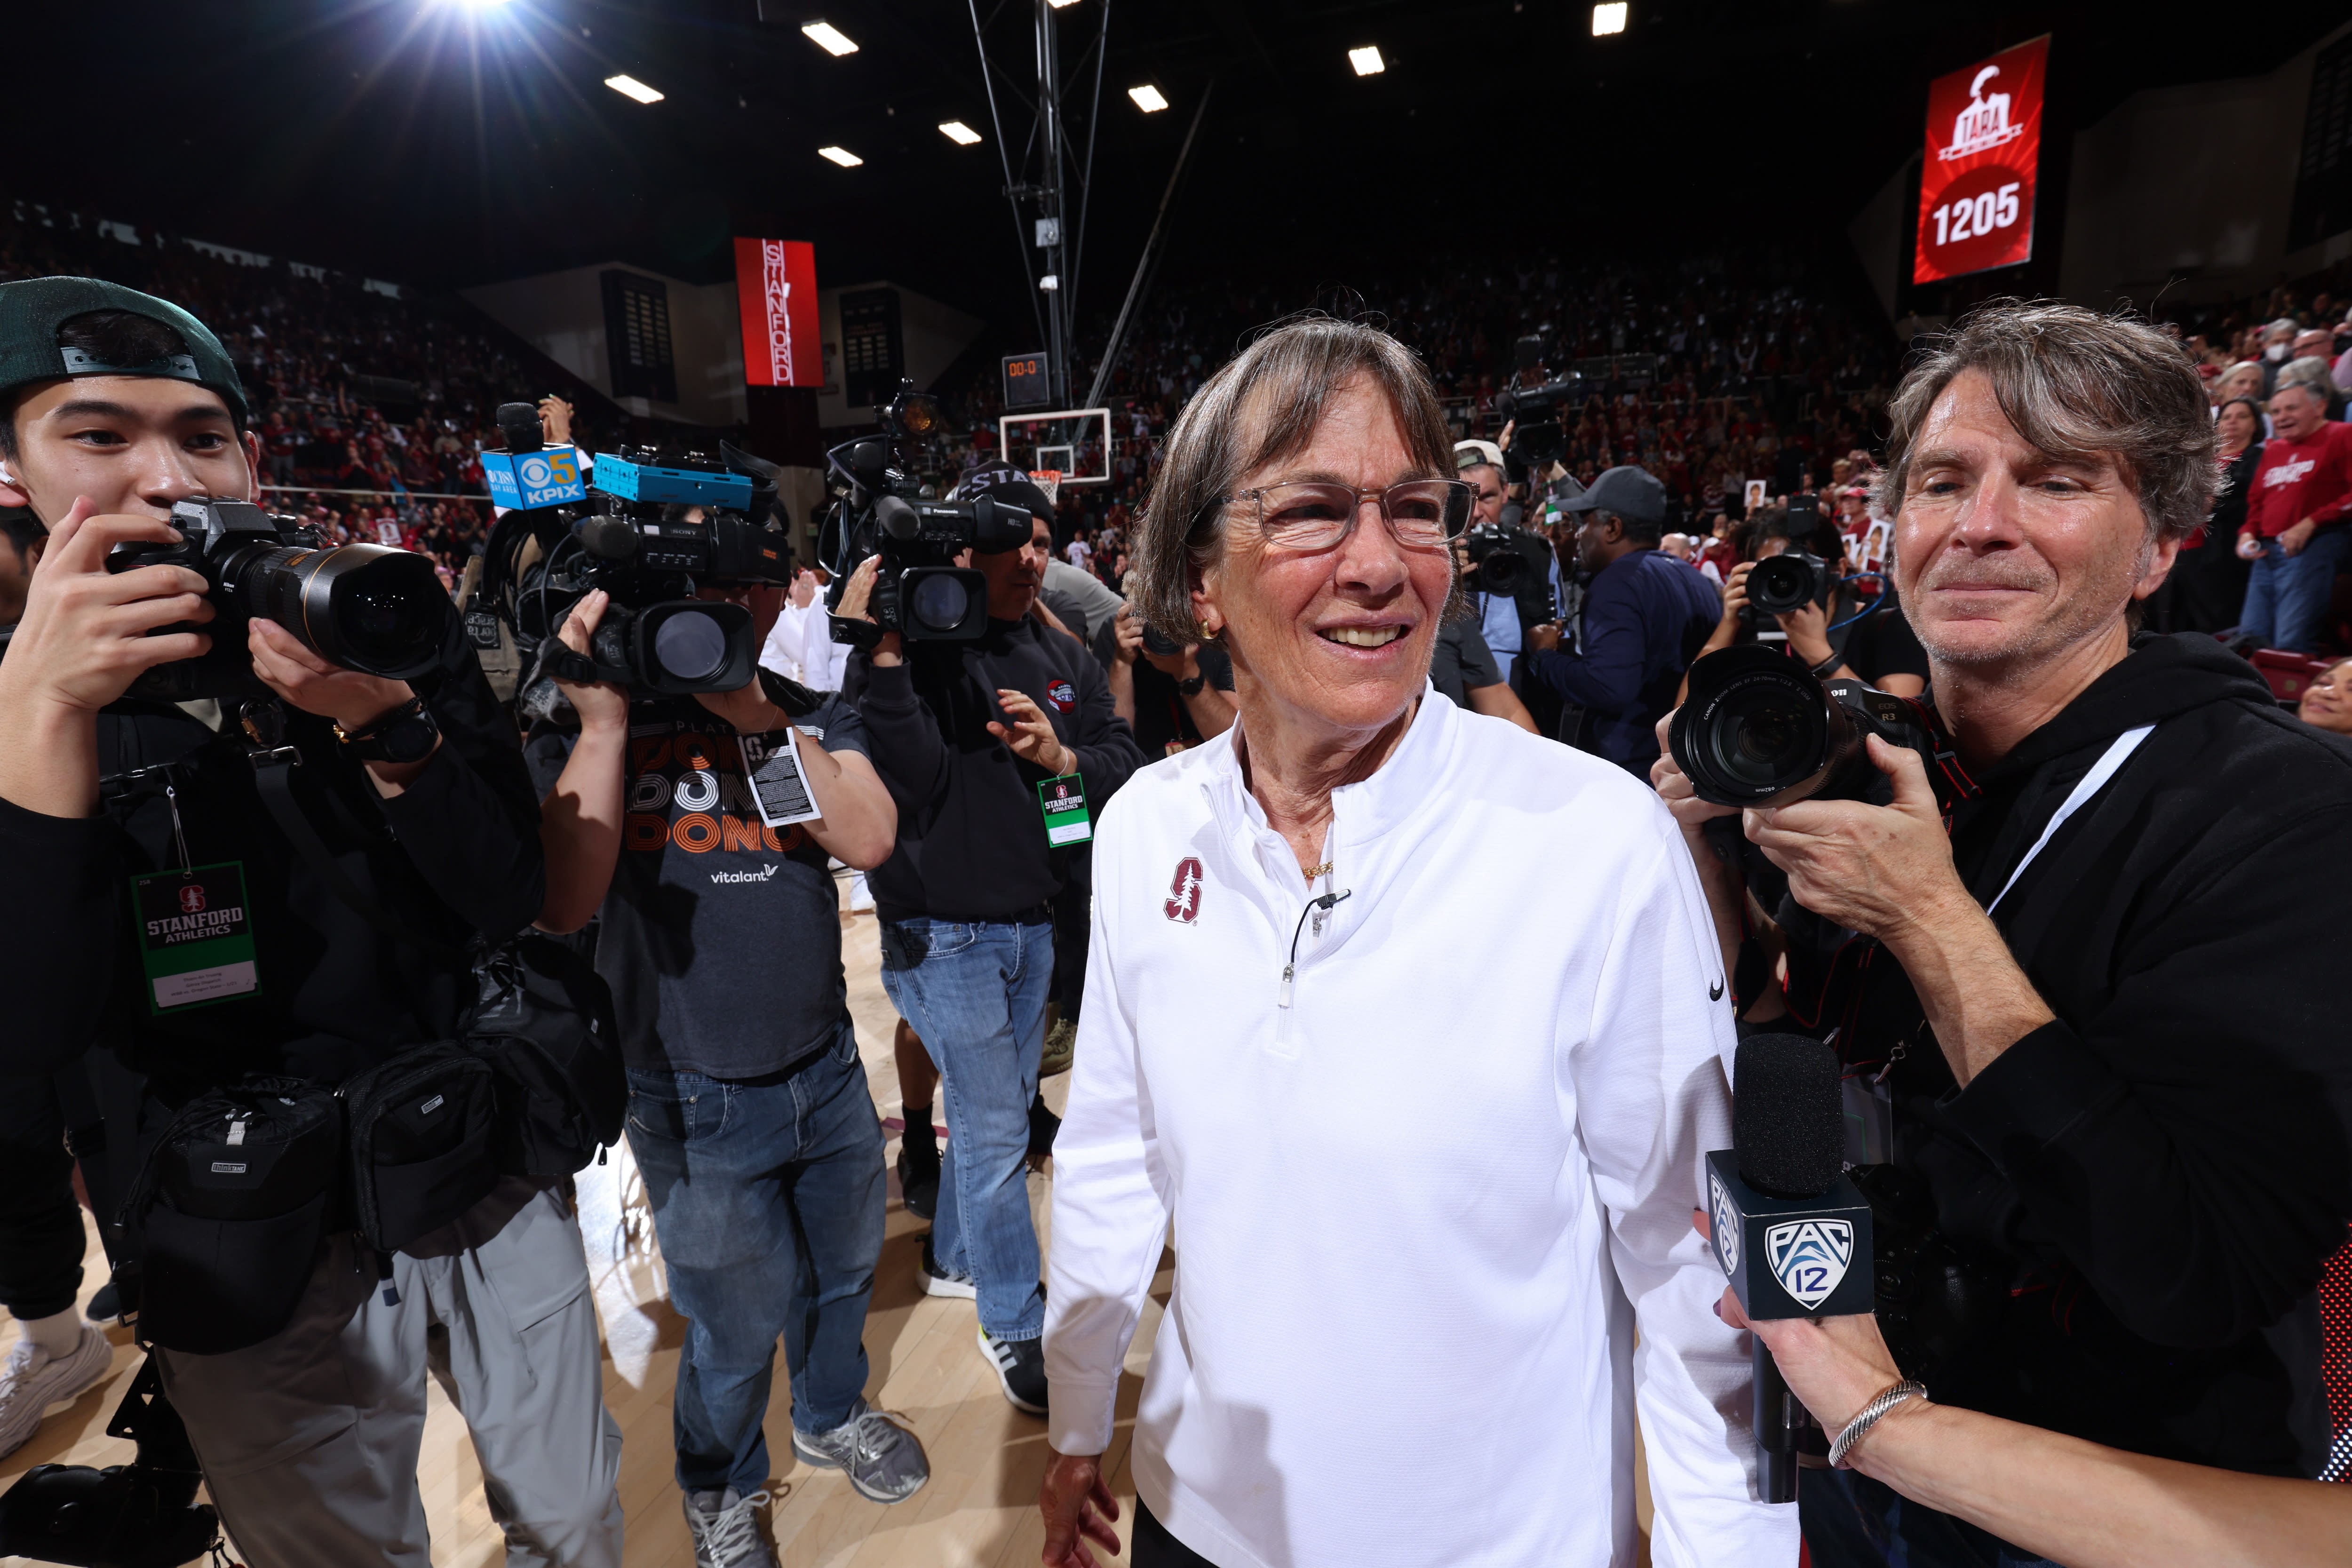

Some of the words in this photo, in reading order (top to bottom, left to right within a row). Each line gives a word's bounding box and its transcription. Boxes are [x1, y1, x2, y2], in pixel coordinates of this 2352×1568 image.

[1933, 182, 2019, 246] 1205
[766, 244, 790, 382] STANFORD
[1009, 360, 1036, 377] 00.0
[548, 453, 576, 484] 5
[527, 484, 580, 504] KPIX
[1704, 703, 1716, 720] CANON
[1715, 689, 1728, 702] ZOOM
[1730, 681, 1742, 690] LENS
[1801, 691, 1811, 701] USM
[628, 771, 759, 812] DON
[1045, 795, 1083, 809] STANFORD
[1052, 804, 1078, 813] ATHLETICS
[147, 907, 244, 936] STANFORD
[165, 924, 231, 944] ATHLETICS
[1770, 1223, 1849, 1278] PAC
[1796, 1267, 1828, 1293] 12
